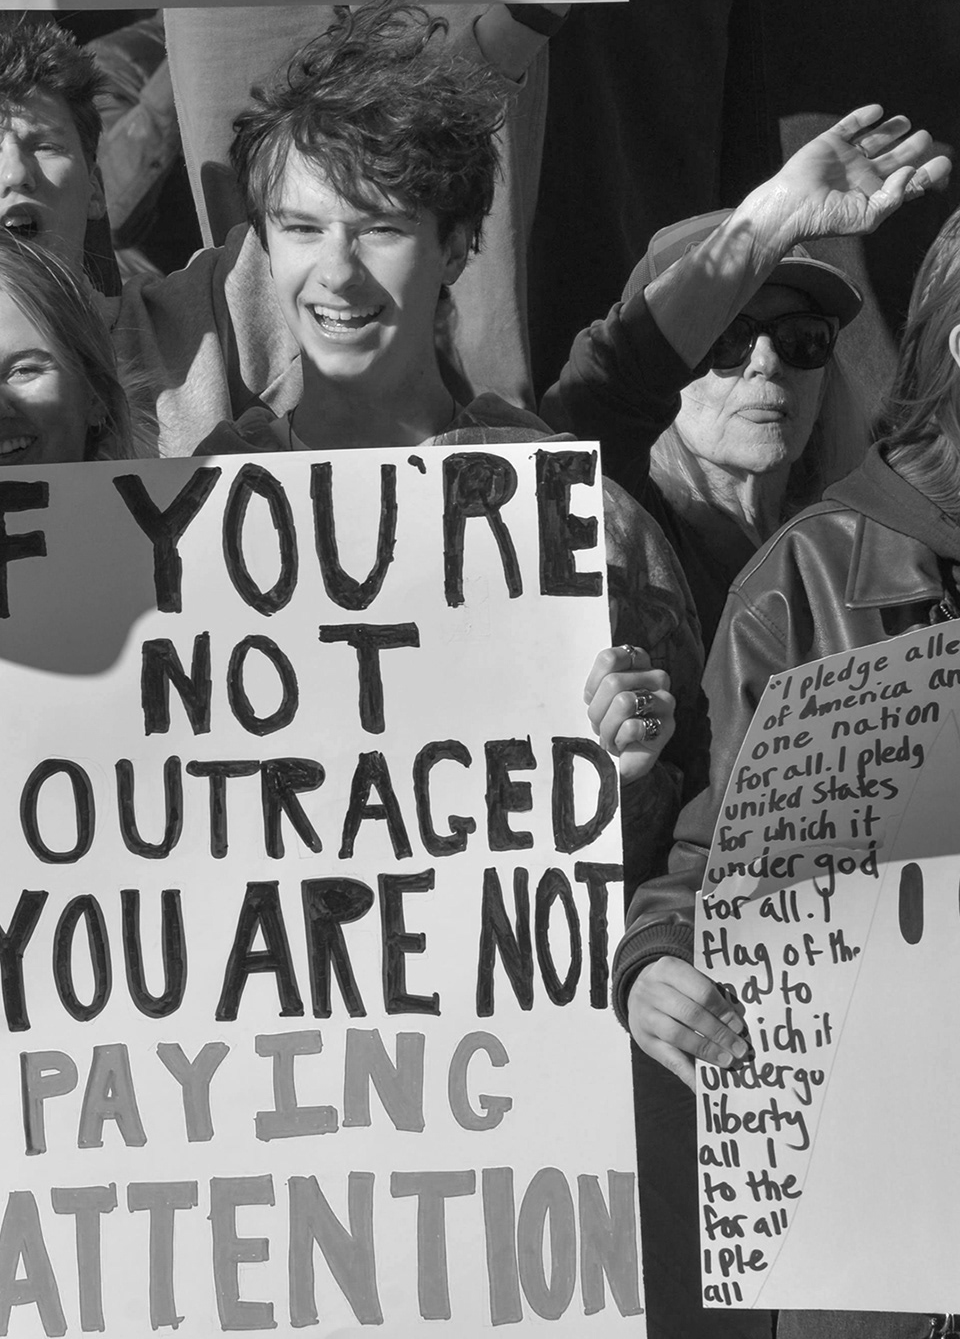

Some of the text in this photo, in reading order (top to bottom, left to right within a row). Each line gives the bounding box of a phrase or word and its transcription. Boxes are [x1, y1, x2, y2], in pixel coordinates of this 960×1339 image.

[112, 449, 603, 616] YOU'RE
[140, 621, 421, 737] NOT
[800, 656, 889, 700] pledge
[763, 704, 793, 731] of
[799, 681, 913, 720] America
[751, 701, 940, 760] one nation
[735, 765, 778, 794] for
[783, 752, 832, 781] all.
[18, 733, 620, 863] OUTRAGED
[717, 804, 881, 852] for which it
[708, 840, 879, 898] under god
[214, 868, 441, 1022] ARE
[475, 861, 624, 1018] NOT
[783, 933, 824, 966] of
[779, 970, 813, 1005] to
[757, 1006, 808, 1054] ich
[18, 1028, 513, 1156] PAYING
[703, 1092, 810, 1151] liberty
[699, 1138, 741, 1168] all
[703, 1169, 803, 1203] to the
[703, 1205, 789, 1241] for all
[703, 1281, 744, 1306] all
